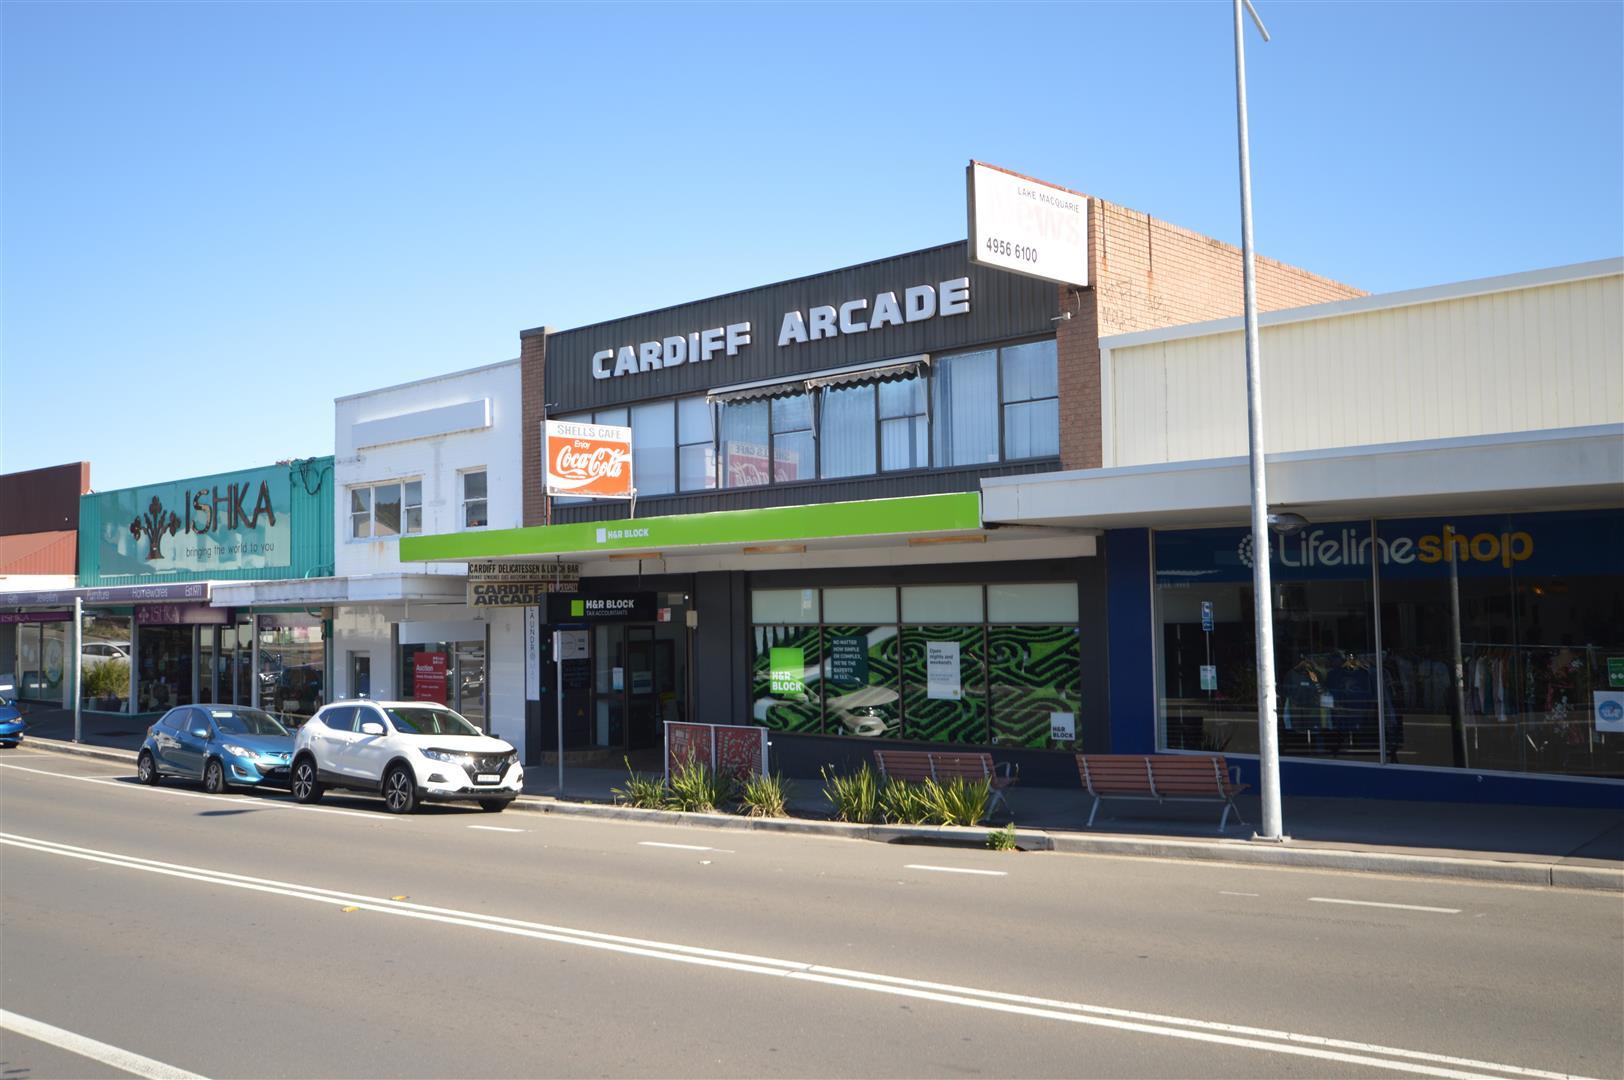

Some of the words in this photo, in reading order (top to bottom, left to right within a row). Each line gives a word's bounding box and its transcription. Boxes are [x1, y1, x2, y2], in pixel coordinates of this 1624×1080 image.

[1017, 187, 1037, 200] LAKE
[1039, 193, 1080, 213] MACQUARIE
[986, 237, 1012, 257] 4956
[1015, 244, 1038, 263] 6100
[592, 321, 751, 380] CARDIFF
[777, 276, 970, 347] ARCADE
[557, 424, 596, 437] SHELLS
[598, 428, 621, 439] CAFE
[574, 440, 591, 450] Enjoy
[185, 480, 276, 535] ISHKA
[607, 530, 623, 539] H&R
[624, 528, 649, 538] BLOCK
[185, 545, 212, 558] bringing
[214, 544, 225, 554] the
[228, 543, 248, 554] world
[250, 543, 258, 552] to
[260, 543, 275, 552] you
[469, 563, 496, 574] CARDIFF
[498, 563, 540, 574] DELICATESSEN
[541, 564, 546, 573] &
[567, 564, 580, 573] BAR
[132, 587, 168, 598] Homewares
[473, 584, 544, 595] CARDIFF
[586, 599, 605, 609] H&R
[606, 599, 635, 609] BLOCK
[150, 605, 180, 623] ISHKA
[771, 671, 791, 681] H&R
[772, 682, 802, 691] BLOCK
